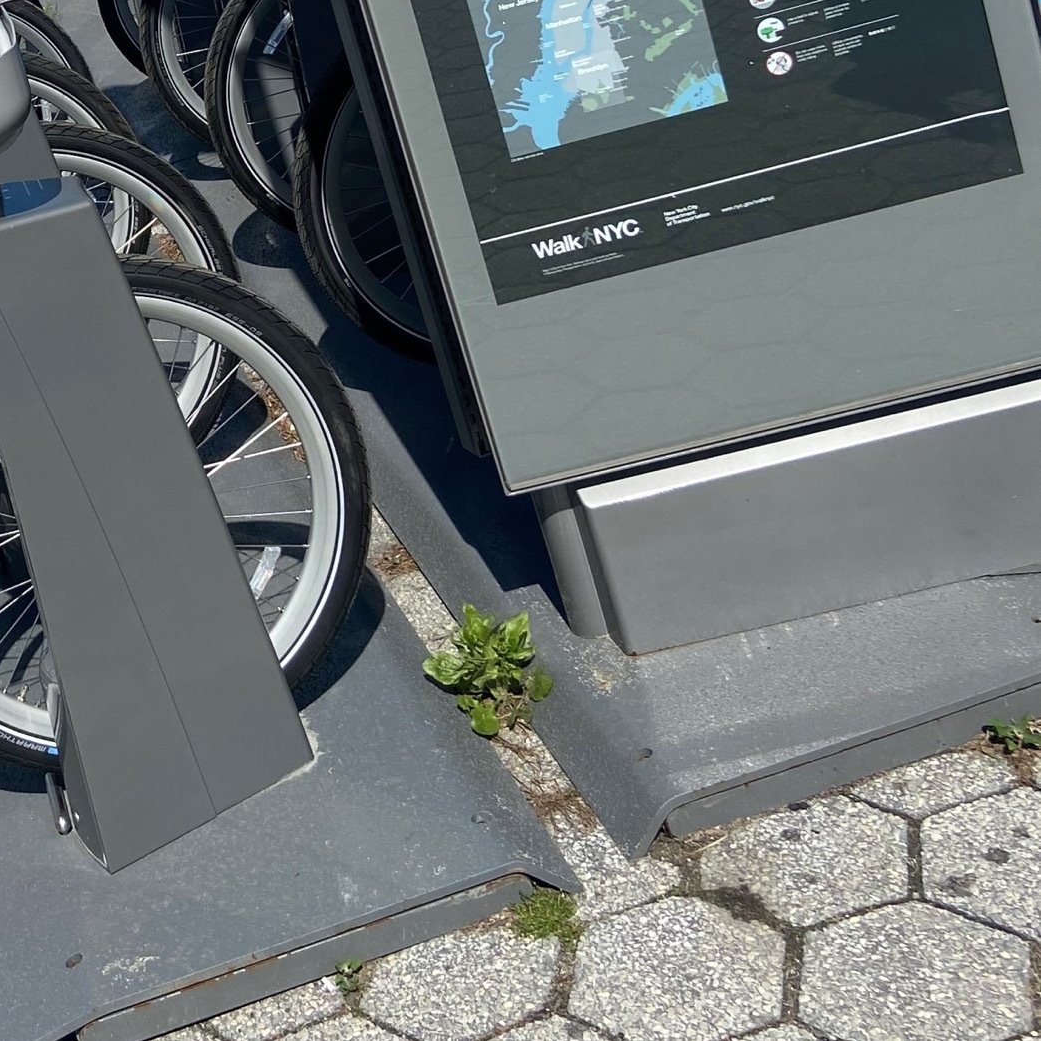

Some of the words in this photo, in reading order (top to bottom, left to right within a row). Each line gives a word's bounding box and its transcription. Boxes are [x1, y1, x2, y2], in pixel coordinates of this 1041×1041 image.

[498, 2, 514, 11] New
[545, 15, 582, 30] Manhattan
[578, 63, 609, 75] Brooklyn
[531, 237, 583, 259] Walk
[592, 218, 640, 244] NYC
